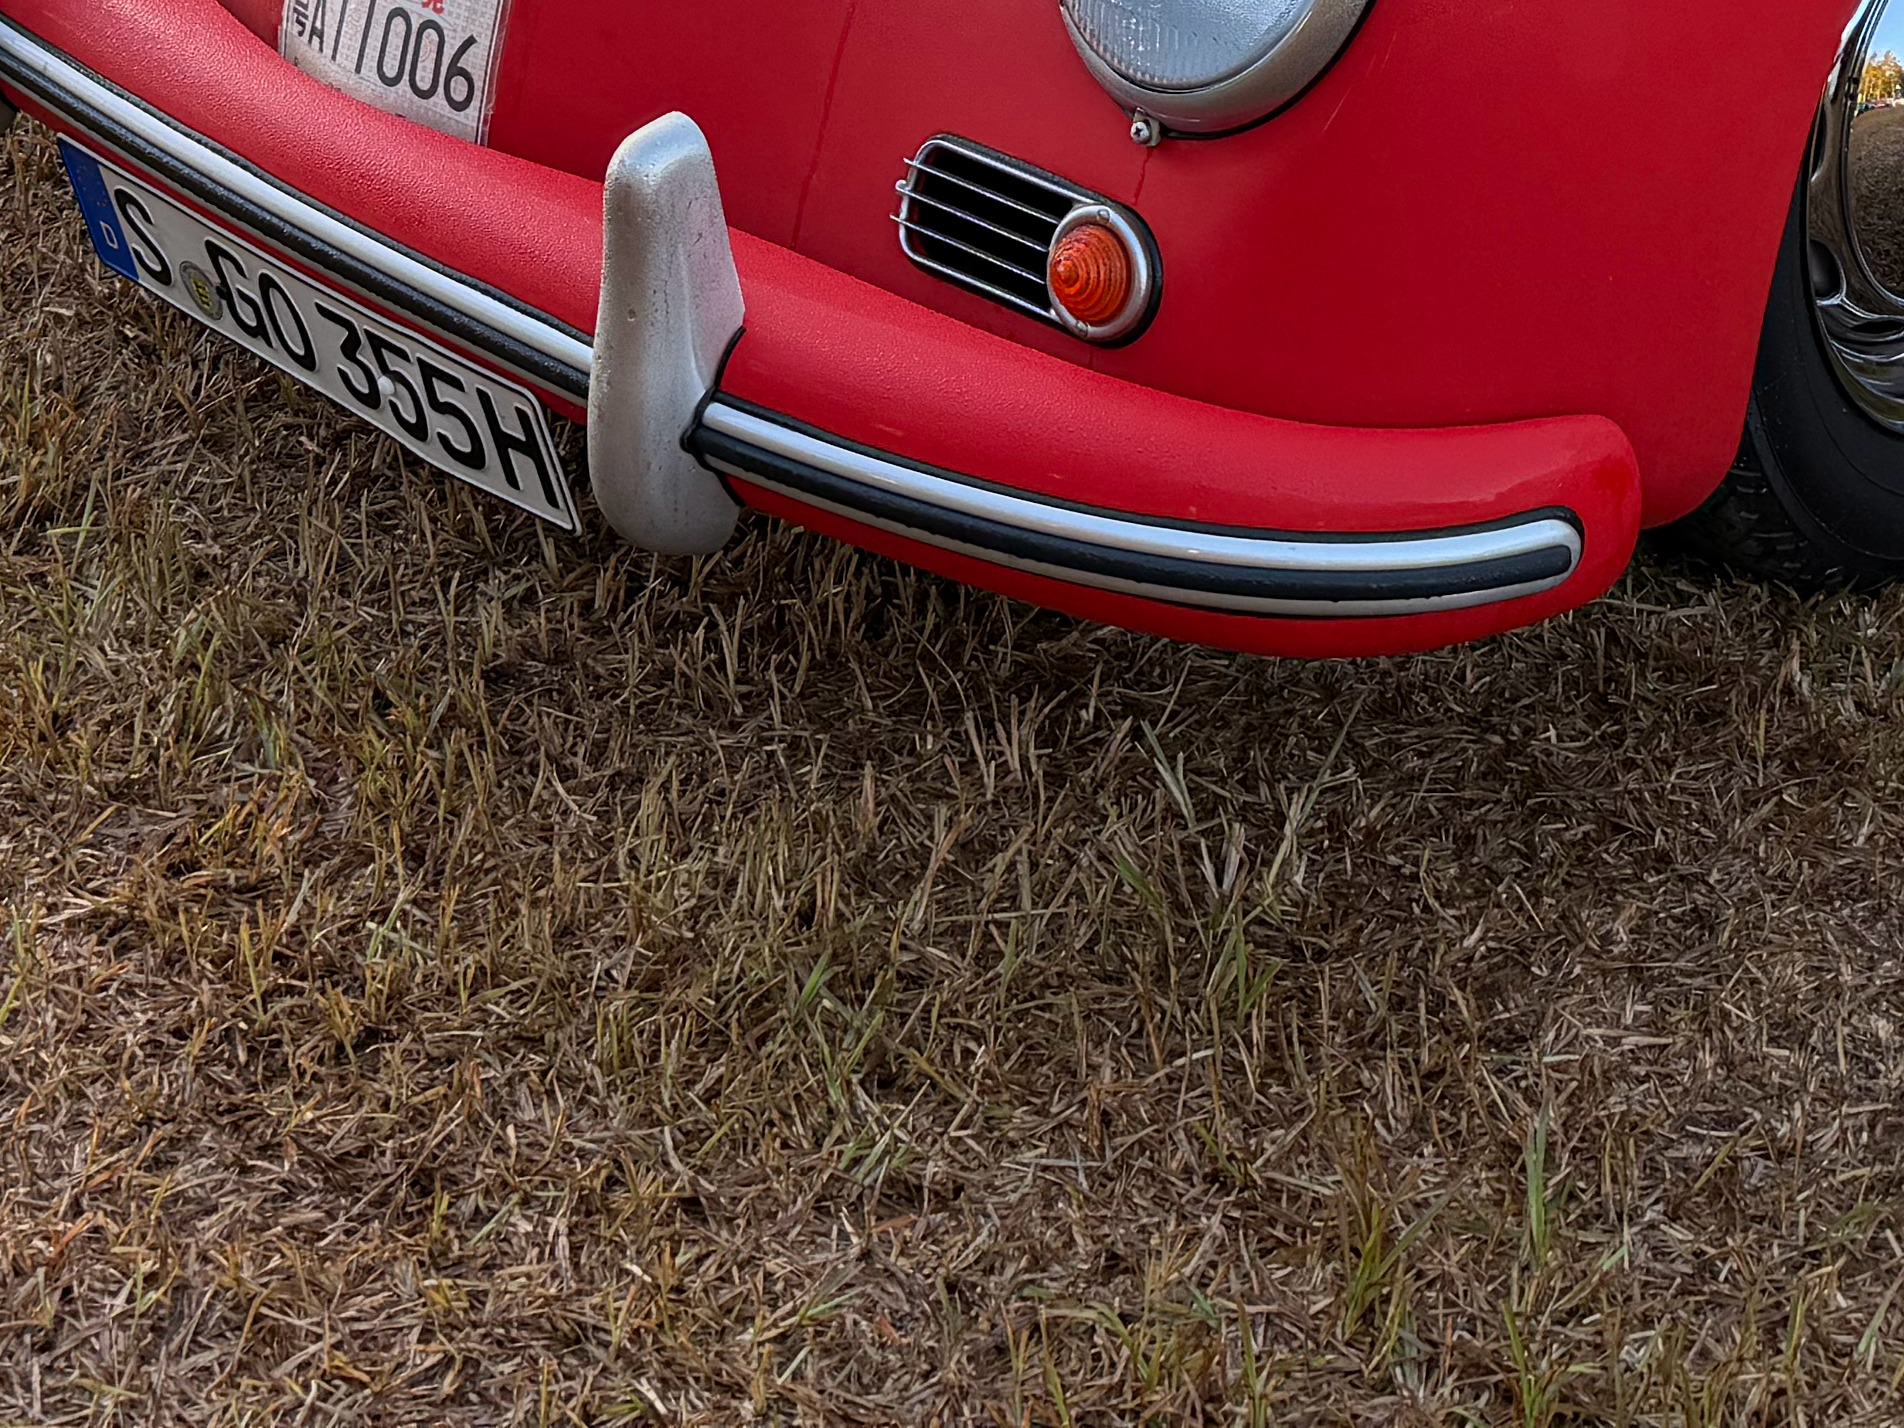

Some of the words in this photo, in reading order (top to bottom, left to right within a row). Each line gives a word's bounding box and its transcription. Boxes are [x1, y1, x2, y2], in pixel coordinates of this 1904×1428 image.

[100, 220, 118, 249] D
[114, 187, 173, 287] S
[204, 238, 318, 372] GO
[314, 300, 561, 510] 355H
